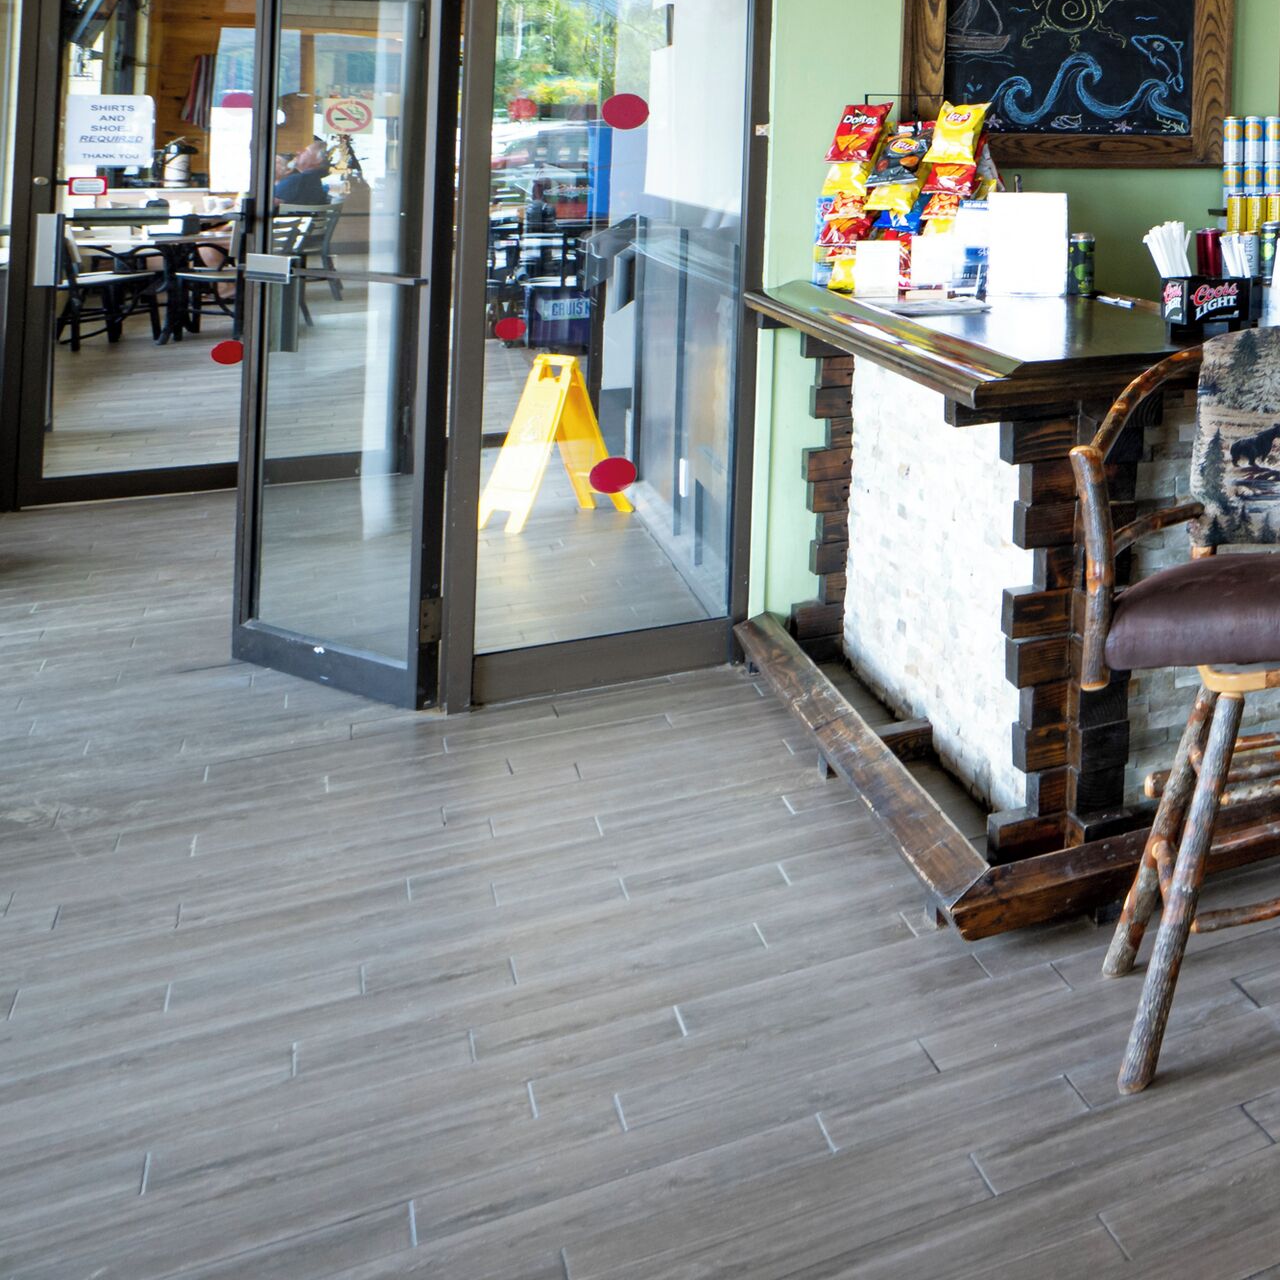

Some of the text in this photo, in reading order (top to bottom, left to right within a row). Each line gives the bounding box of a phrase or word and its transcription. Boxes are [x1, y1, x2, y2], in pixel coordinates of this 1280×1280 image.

[90, 104, 135, 112] SHIRTS
[843, 114, 877, 125] Doritos
[80, 135, 144, 143] REQUIRED
[1190, 282, 1239, 306] Coors
[1195, 295, 1238, 320] LIGHT
